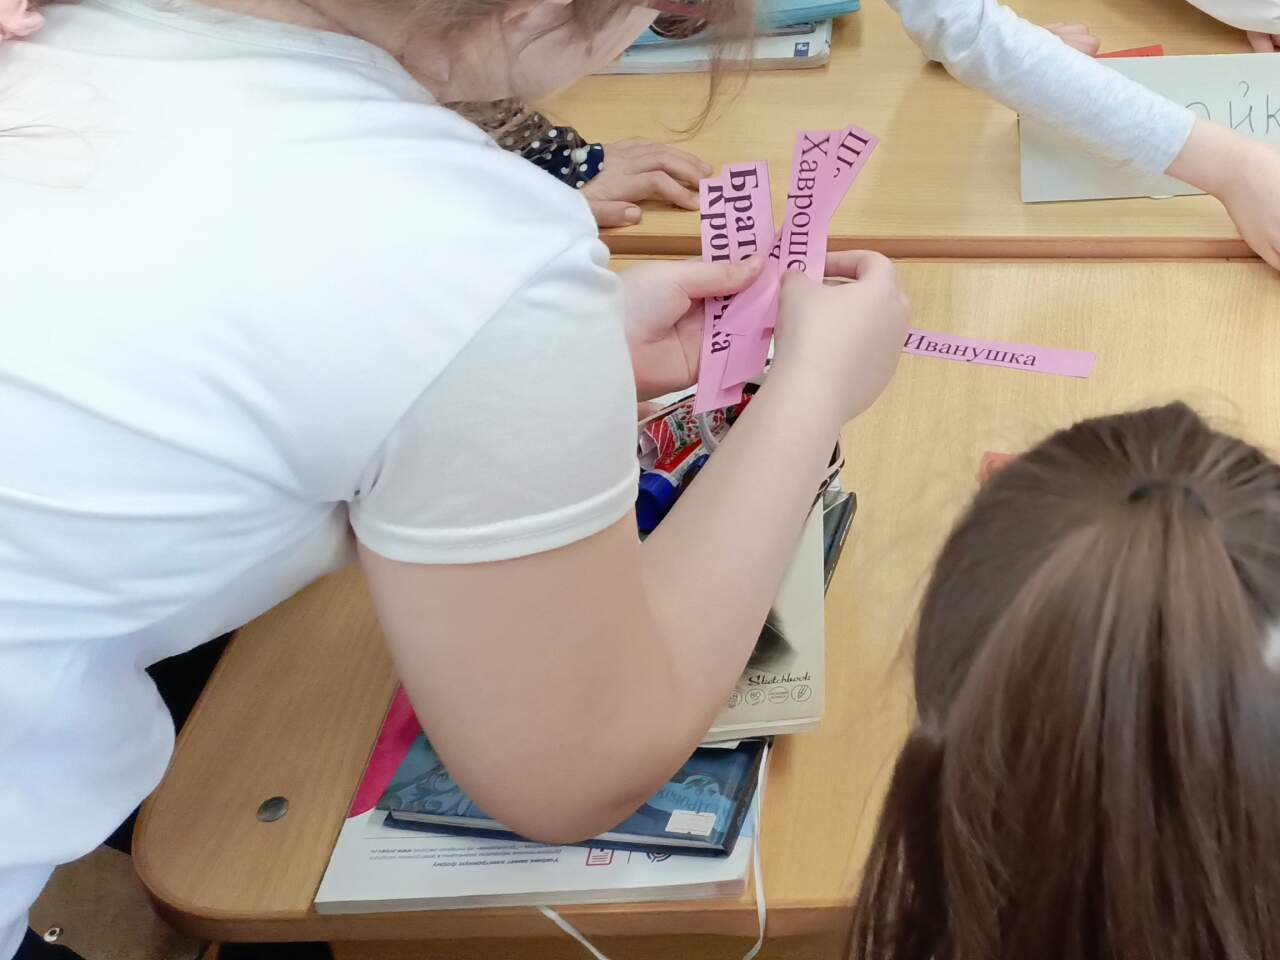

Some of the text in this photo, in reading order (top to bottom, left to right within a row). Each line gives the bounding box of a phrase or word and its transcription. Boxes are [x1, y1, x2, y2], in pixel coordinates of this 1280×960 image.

[724, 164, 758, 261] Брат
[787, 133, 831, 272] Хавроше
[904, 332, 1037, 368] Иванушка
